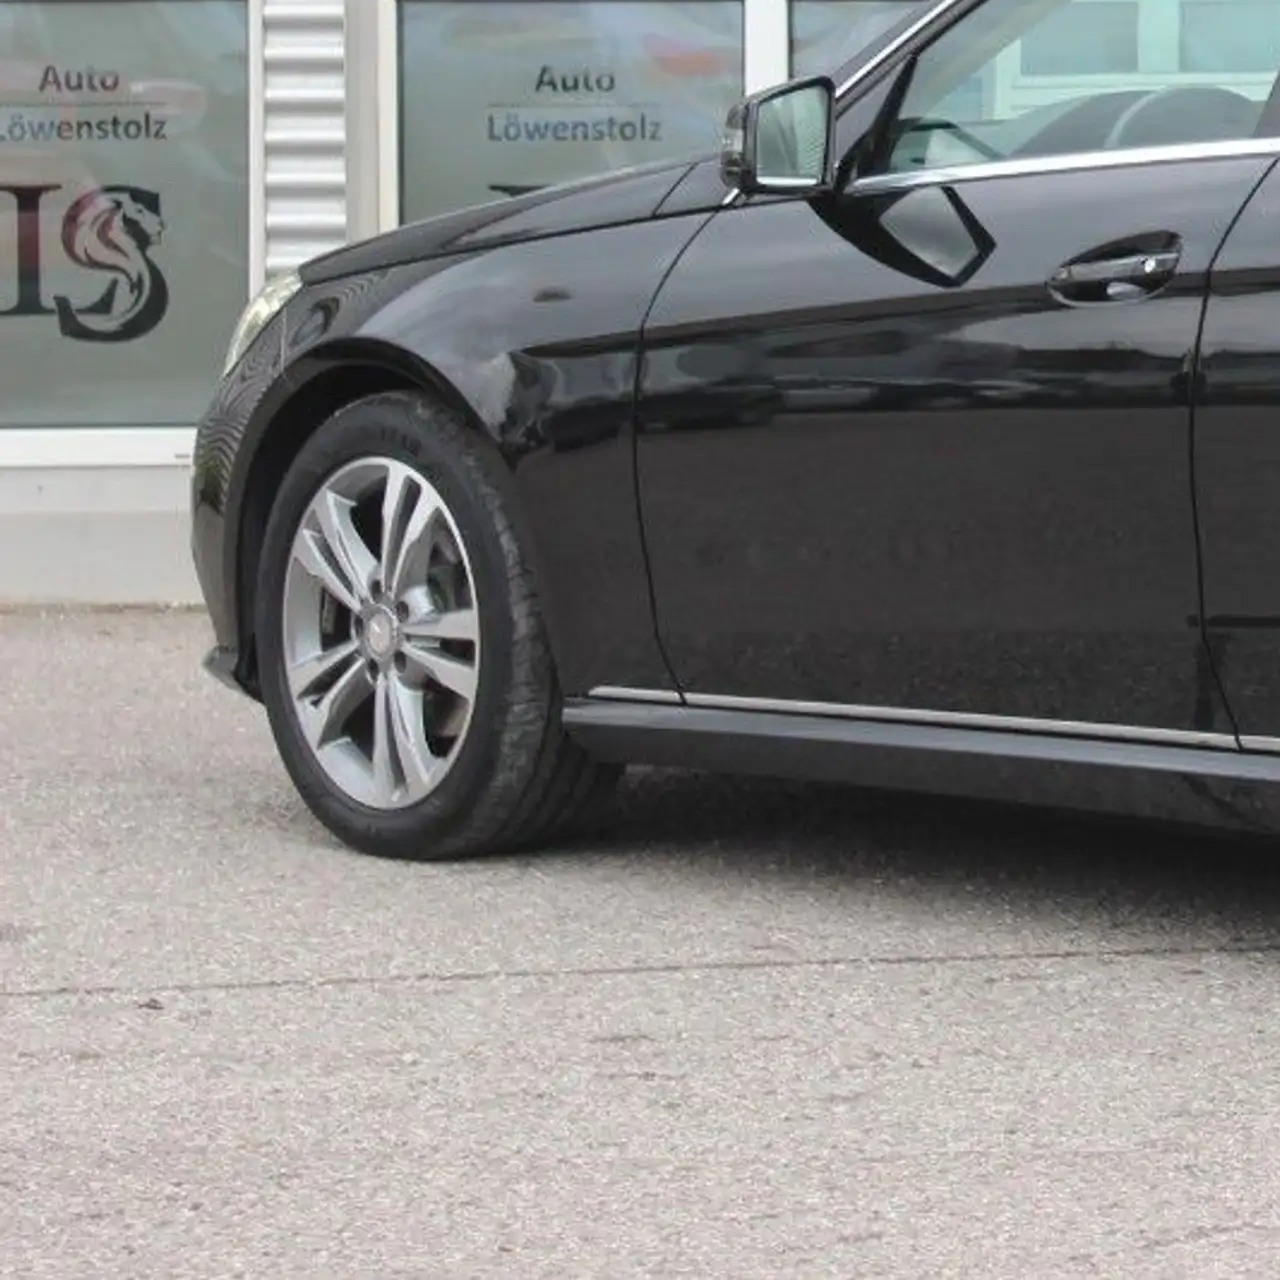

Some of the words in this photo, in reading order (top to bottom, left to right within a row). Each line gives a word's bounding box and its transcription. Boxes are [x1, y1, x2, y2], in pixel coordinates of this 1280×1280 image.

[39, 65, 120, 92] Auto
[535, 65, 616, 93] Auto
[487, 112, 661, 142] Löwenstolz
